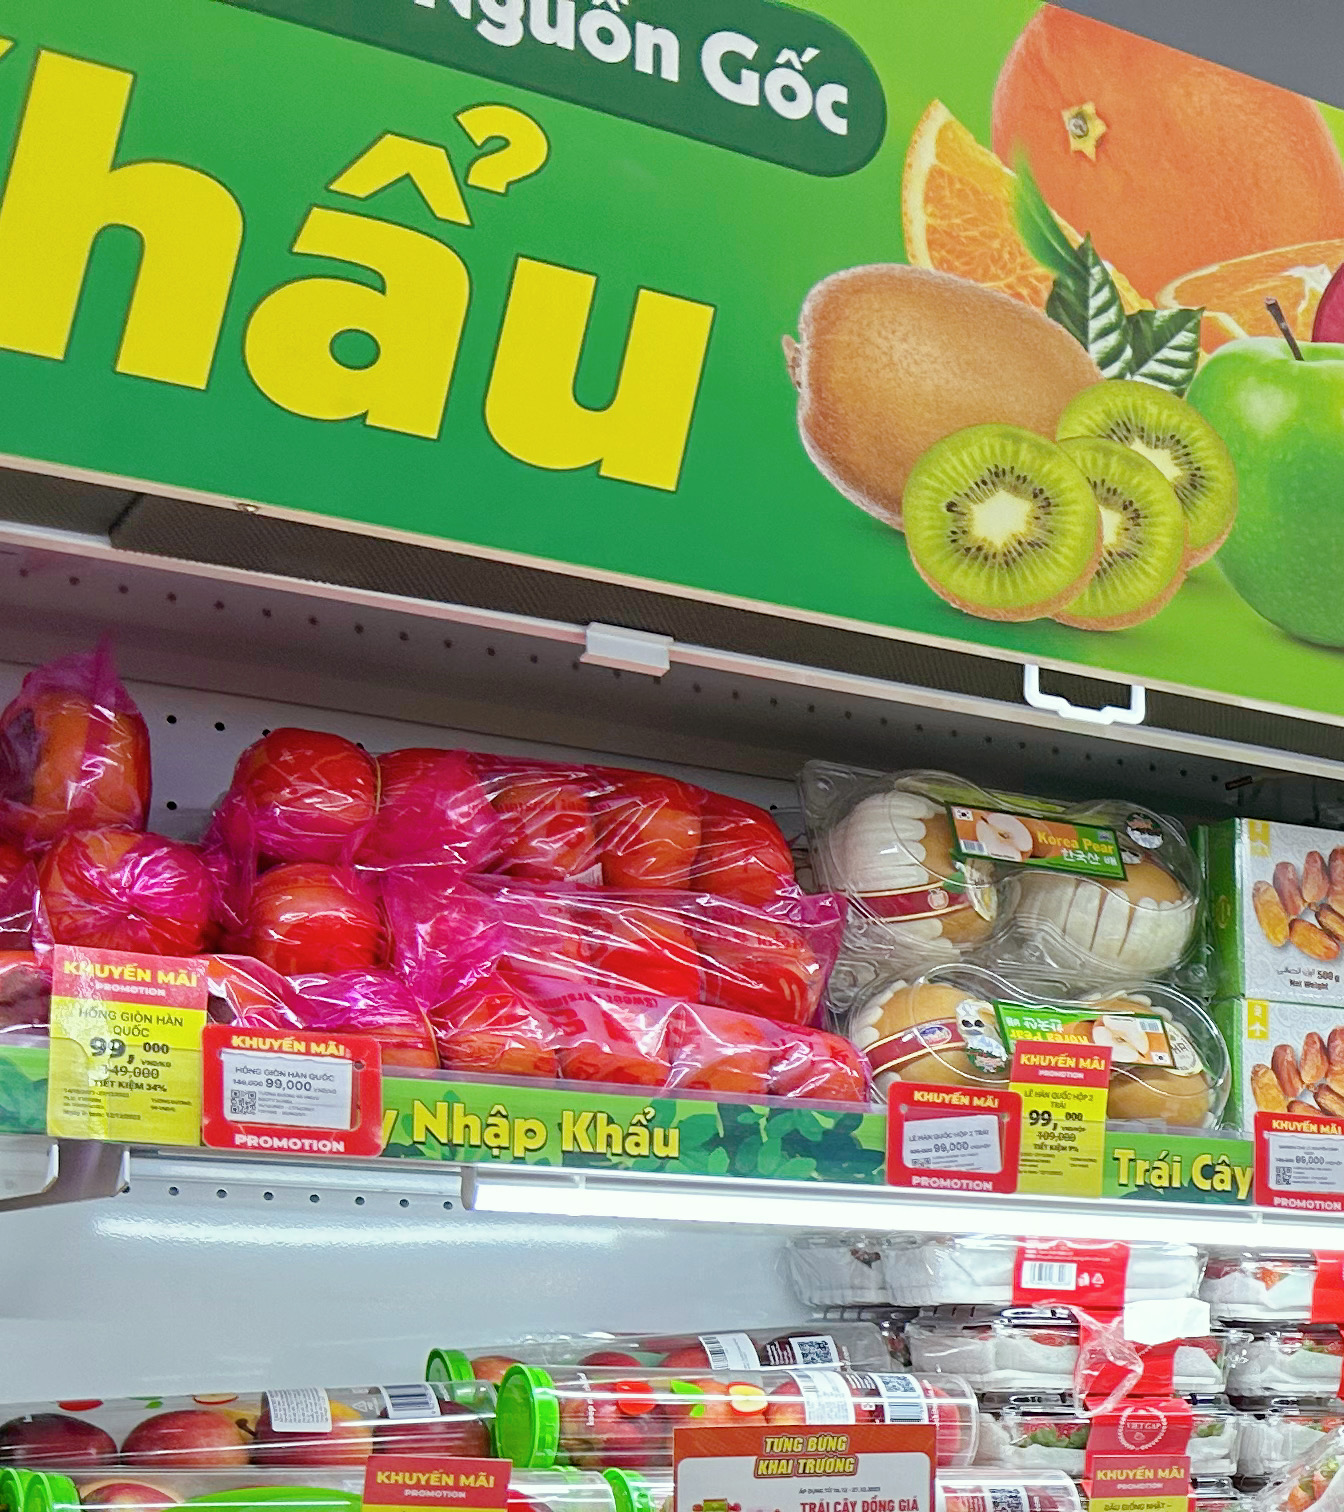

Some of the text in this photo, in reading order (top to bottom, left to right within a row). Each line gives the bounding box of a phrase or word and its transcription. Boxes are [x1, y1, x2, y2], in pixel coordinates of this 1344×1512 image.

[700, 30, 850, 136] Gốc
[1037, 829, 1115, 856] Korea Pear
[1062, 847, 1101, 865] 한국산
[63, 959, 198, 988] KHUYẾN MÃI
[1316, 969, 1333, 983] 500
[1289, 978, 1302, 989] Net
[231, 1034, 345, 1056] KHUYẾN MÃI
[1020, 1053, 1106, 1070] KHUYẾN MÃI
[265, 1078, 312, 1092] 99,000
[913, 1089, 999, 1108] KHUYẾN MÃI
[411, 1100, 548, 1157] Nhập
[561, 1104, 681, 1160] Khẩu
[234, 1132, 346, 1153] PROMOTION
[911, 1174, 993, 1191] PROMOTION
[1113, 1147, 1184, 1191] Trái
[1189, 1151, 1254, 1200] Cây
[1273, 1196, 1342, 1211] PROMOTION
[757, 1456, 793, 1475] KHAI
[1096, 1465, 1185, 1480] KHUYẾN MÃI
[376, 1470, 495, 1488] KHUYẾN MÃI
[403, 1488, 467, 1499] PROMOTION
